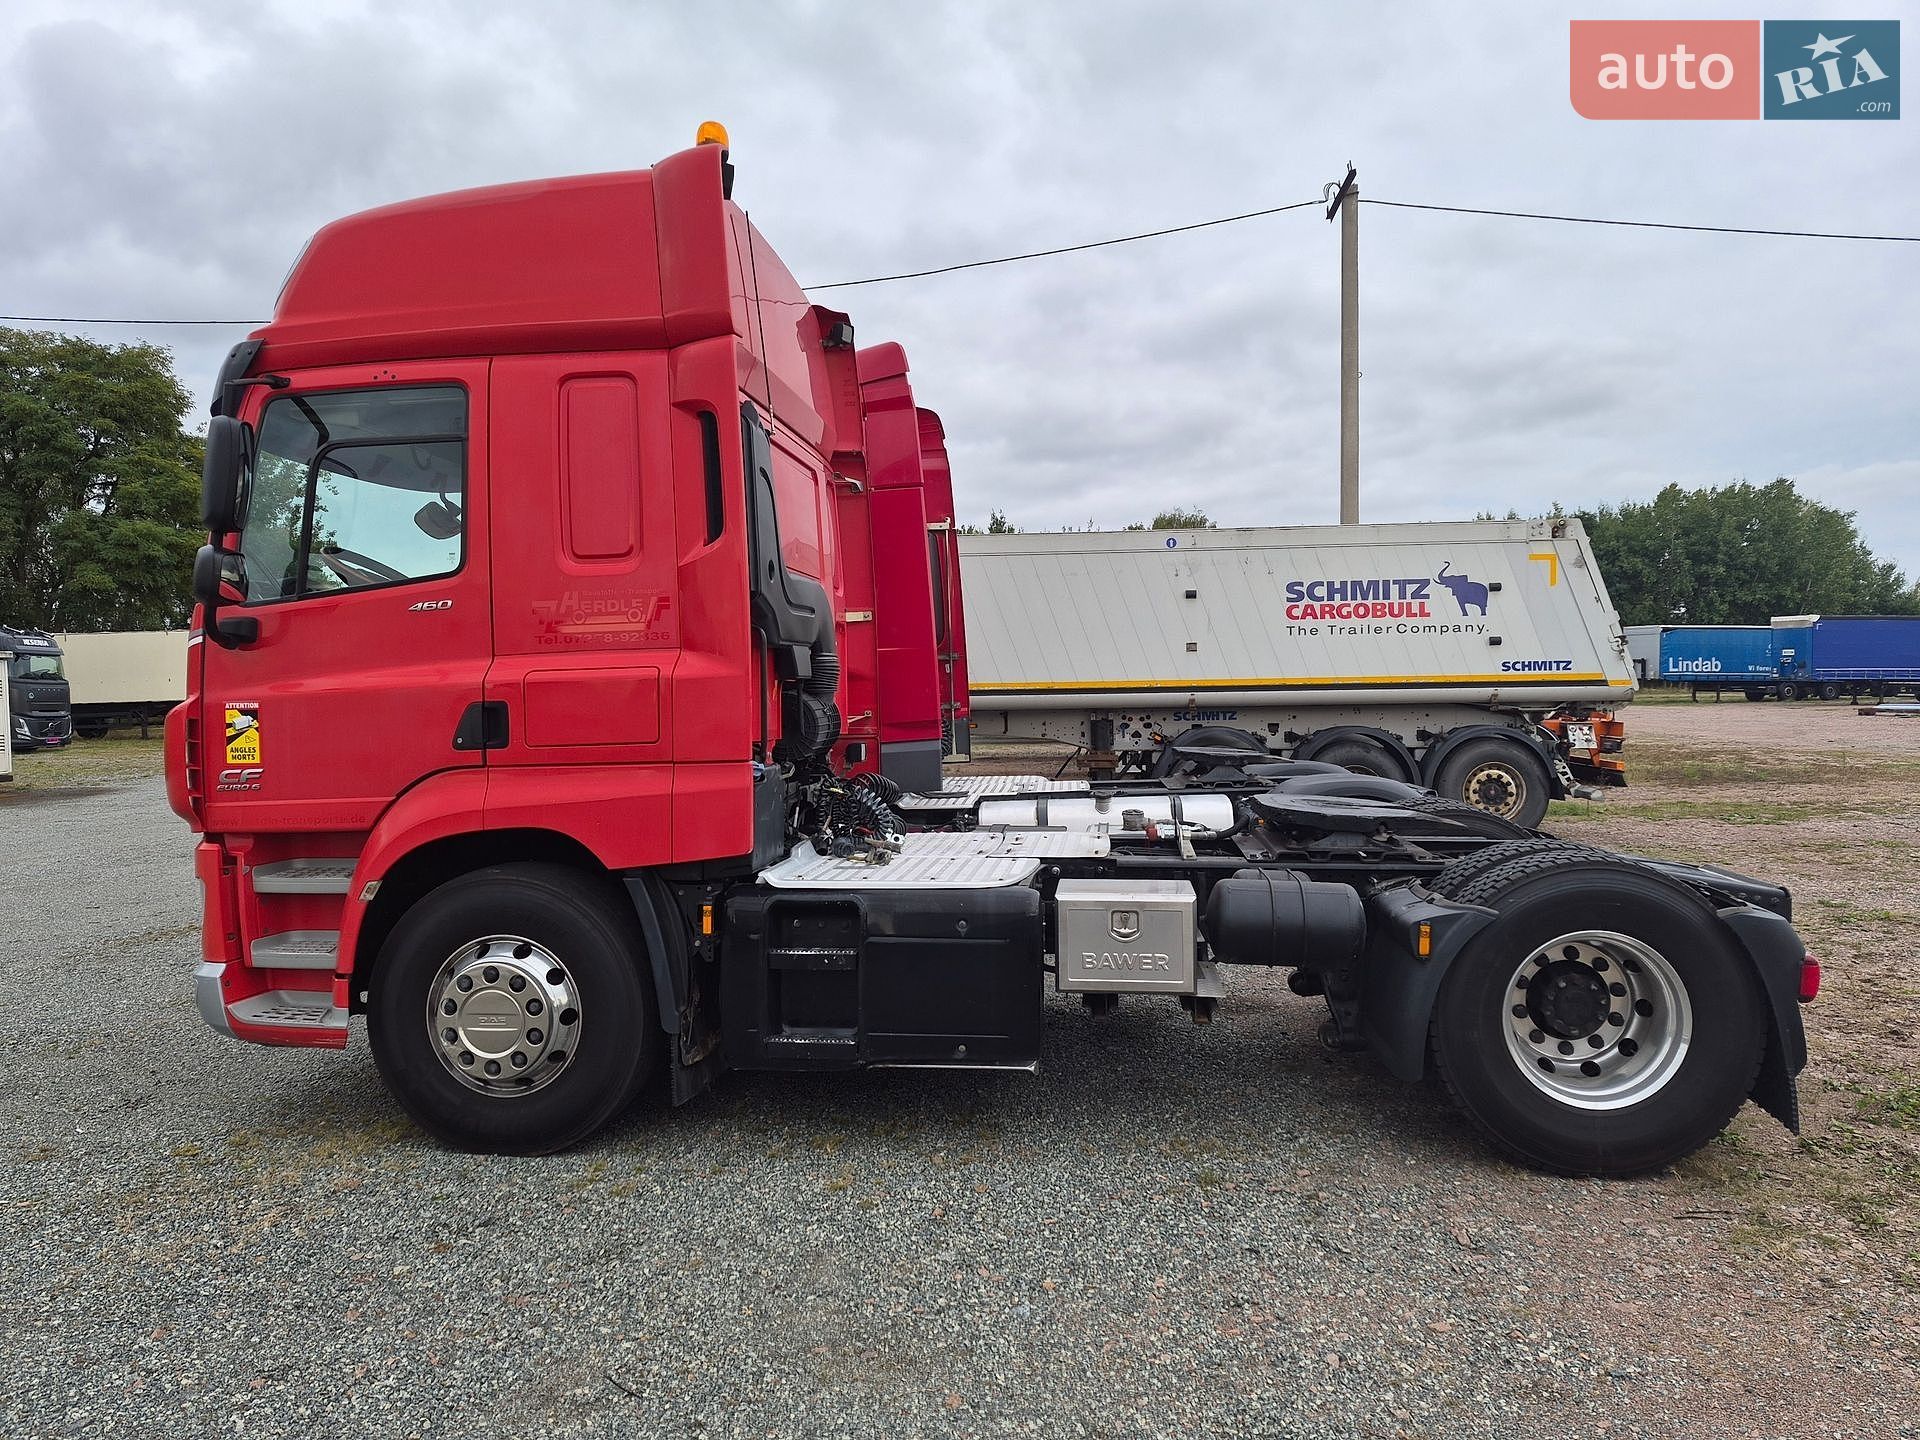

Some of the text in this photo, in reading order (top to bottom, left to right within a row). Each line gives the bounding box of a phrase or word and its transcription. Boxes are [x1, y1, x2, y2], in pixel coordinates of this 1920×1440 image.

[1285, 578, 1431, 603] SCHMITZ
[408, 599, 453, 611] 460
[1285, 601, 1431, 621] CARGOBULL
[1286, 625, 1319, 636] The
[1501, 660, 1573, 672] SCHMITZ
[1668, 657, 1722, 672] Lindab
[1173, 711, 1237, 721] SCHMITZ
[230, 746, 257, 754] ANGLES
[219, 768, 264, 783] CF
[1081, 952, 1169, 971] BAWER
